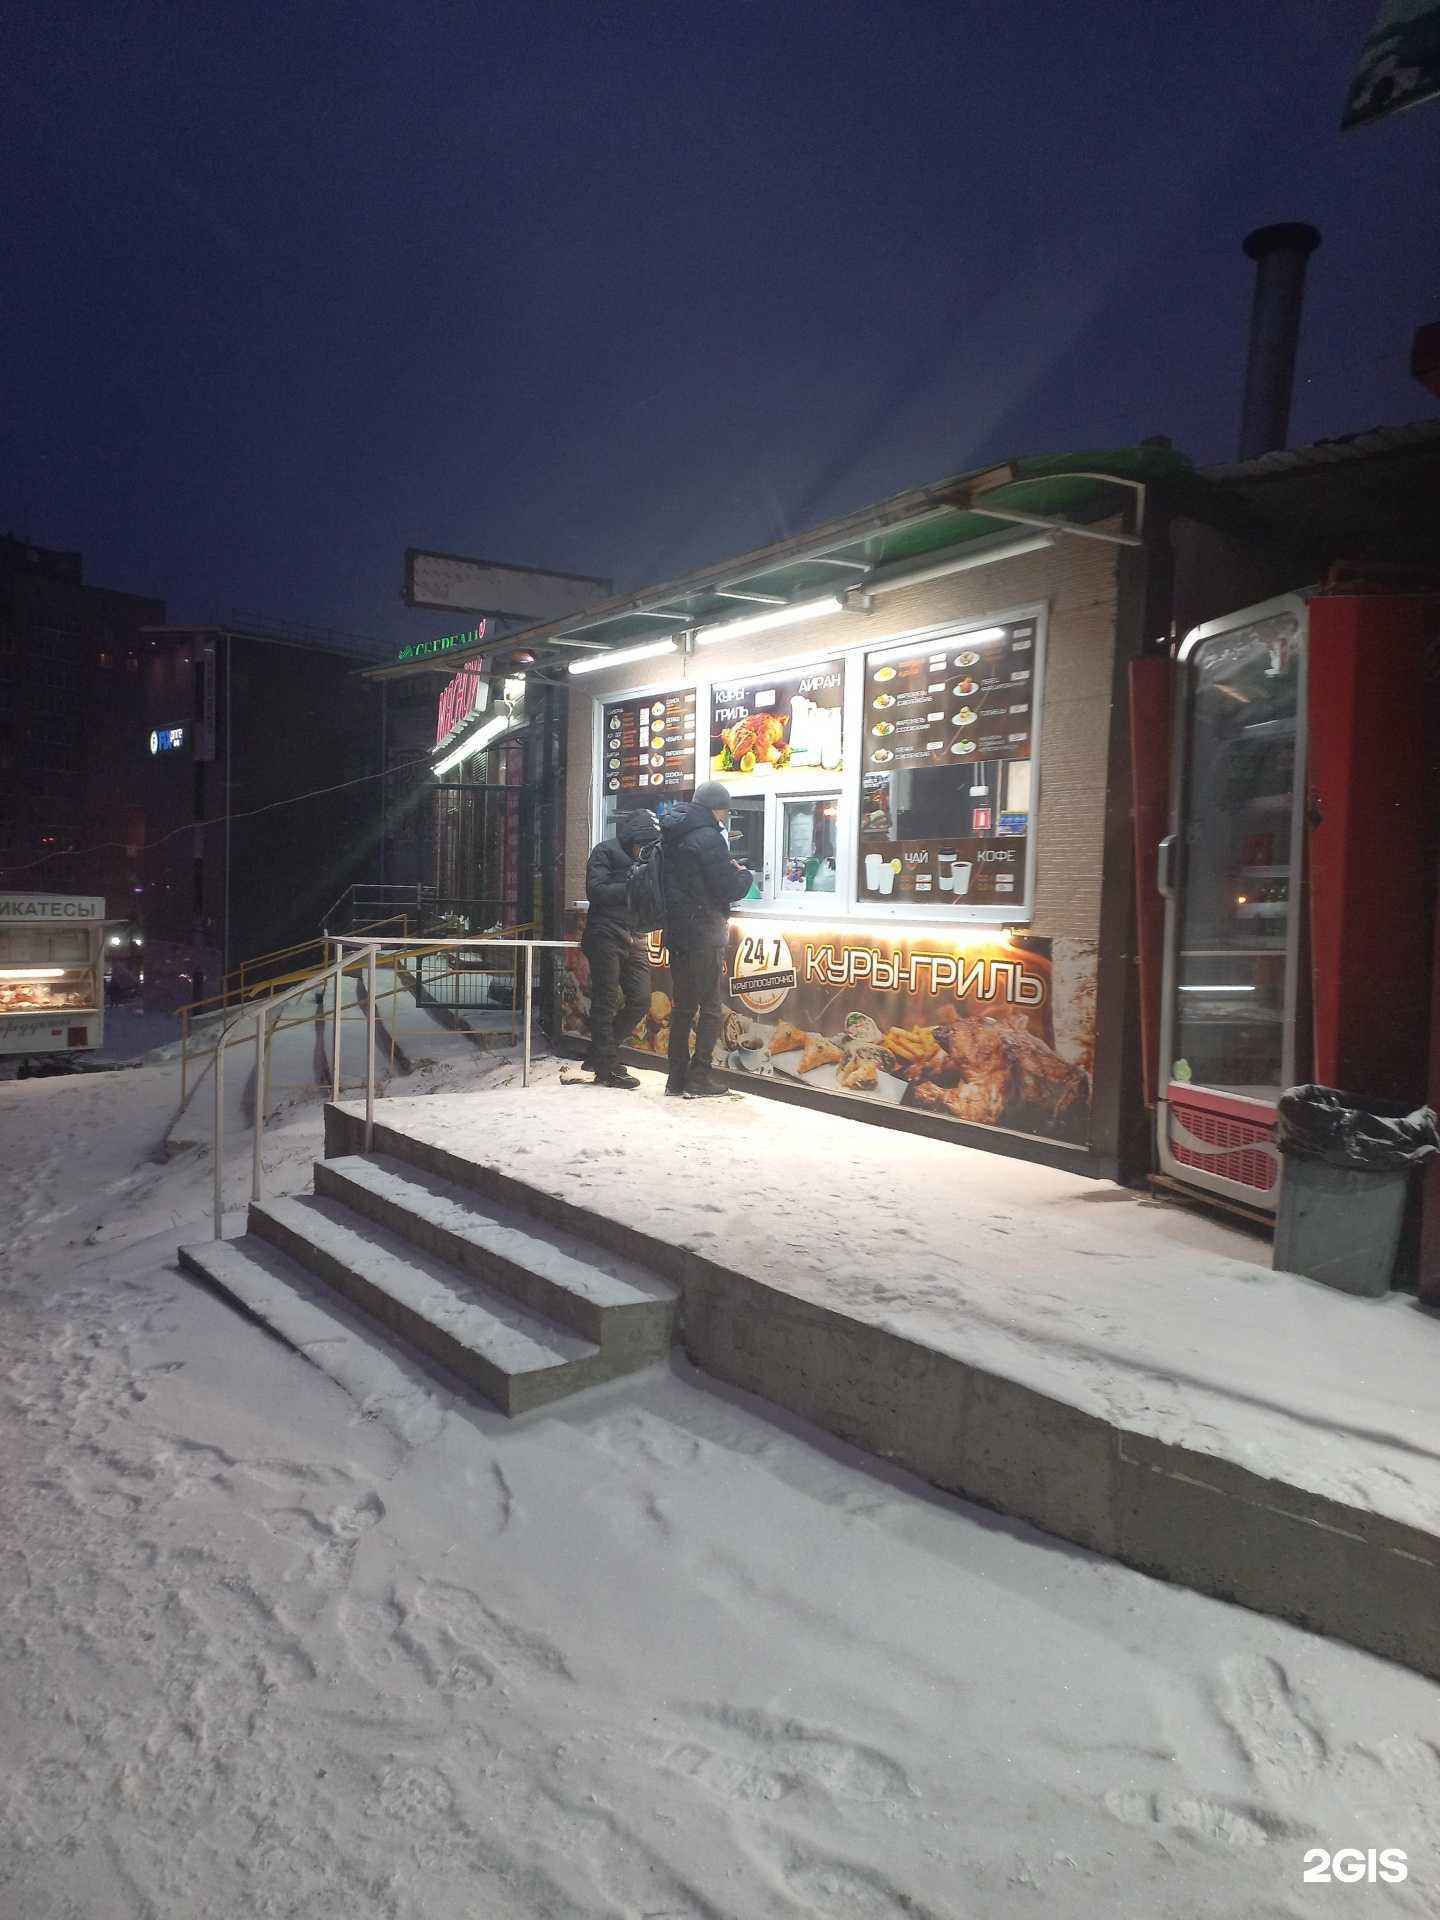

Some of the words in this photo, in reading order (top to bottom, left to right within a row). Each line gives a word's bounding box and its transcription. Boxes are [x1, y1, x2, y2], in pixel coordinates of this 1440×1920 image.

[715, 706, 749, 722] ГРИЛЬ
[904, 849, 929, 863] ЧАЙ
[977, 850, 1016, 862] КОФЕ
[805, 945, 1045, 1006] КУРЫ-ГРИЛЬ
